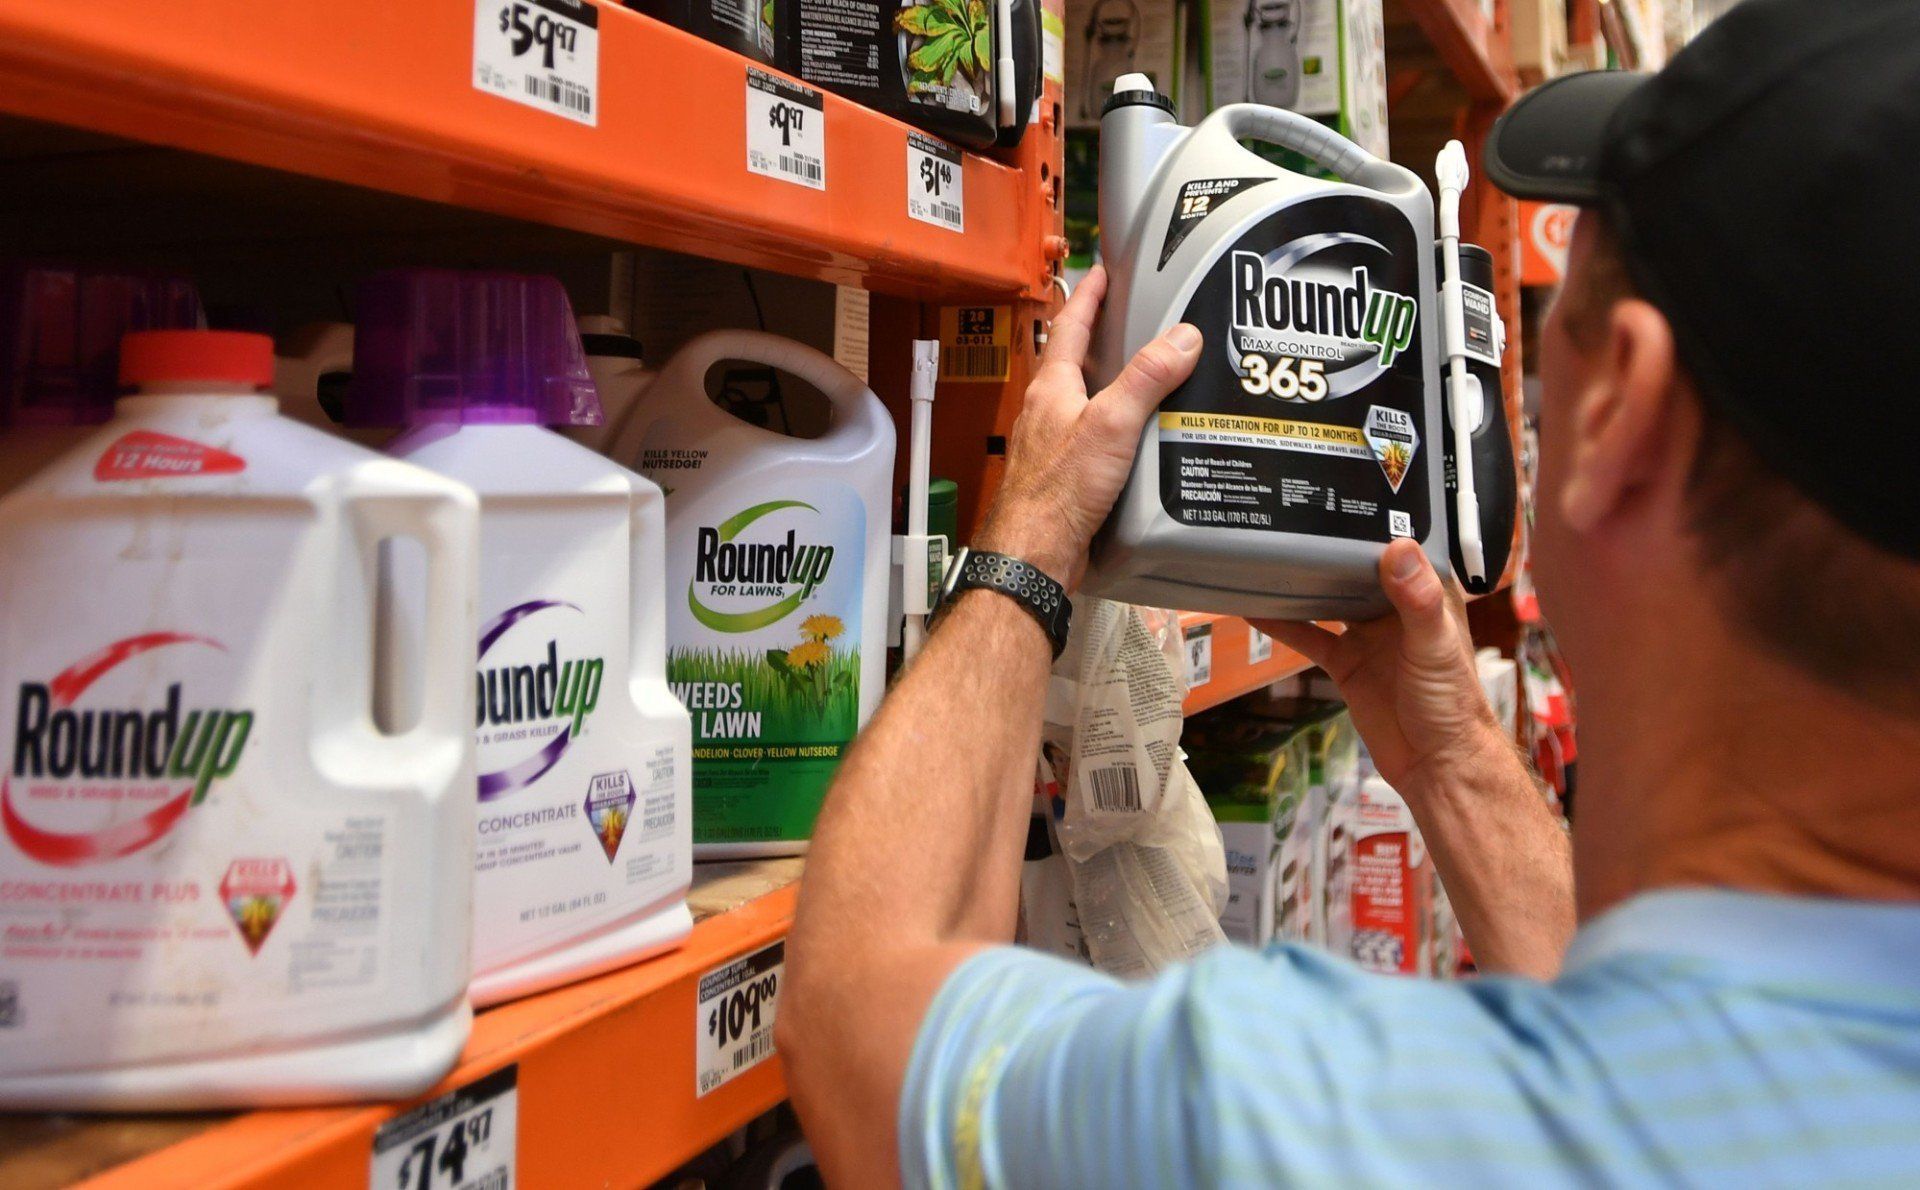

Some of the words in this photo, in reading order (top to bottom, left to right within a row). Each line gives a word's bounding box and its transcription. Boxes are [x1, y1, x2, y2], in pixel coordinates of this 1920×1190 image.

[1187, 181, 1214, 191] KILLS
[1215, 180, 1239, 188] AND
[1182, 196, 1210, 214] 12
[1180, 211, 1208, 220] MONTHS
[1232, 250, 1417, 368] Roundup
[1464, 297, 1490, 315] WAND
[1241, 336, 1275, 351] MAX
[1278, 342, 1345, 361] CONTROL
[1241, 353, 1328, 402] 365
[1375, 409, 1407, 426] KILLS
[1181, 417, 1205, 427] KILLS
[1208, 418, 1260, 431] VEGETATION
[1263, 423, 1279, 433] FOR
[1283, 425, 1294, 434] UP
[1298, 426, 1308, 436] TO
[1310, 428, 1319, 437] 12
[1323, 429, 1358, 442] MONTHS
[1376, 422, 1387, 430] THE
[1388, 423, 1407, 433] ROOTS
[643, 450, 669, 459] KILLS
[671, 450, 709, 459] YELLOW
[1219, 435, 1254, 443] DRIVEWAYS,
[1257, 437, 1277, 446] PATIOS,
[1280, 440, 1312, 449] SIDEWALKS
[1327, 445, 1348, 454] GRAVEL
[1350, 447, 1367, 456] AREAS
[142, 454, 203, 472] Hours
[642, 459, 702, 470] NUTSEDGE!
[1181, 457, 1194, 466] Keep
[1195, 457, 1204, 465] Out
[1205, 457, 1209, 465] of
[1210, 458, 1225, 466] Reach
[1226, 459, 1231, 467] of
[1232, 459, 1252, 468] Children
[1181, 466, 1209, 477] CAUTION
[1181, 488, 1221, 502] PRECAUCIÓN
[1183, 509, 1197, 520] NET
[1199, 510, 1211, 521] 1.33
[1212, 511, 1226, 522] GAL
[1227, 511, 1240, 523] (170
[1241, 513, 1249, 523] FL
[1250, 513, 1272, 526] OZ/5L)
[696, 526, 834, 601] Roundup
[711, 585, 736, 596] FOR
[476, 639, 604, 738] undup
[670, 682, 742, 709] WEEDS
[494, 730, 527, 743] GRASS
[530, 725, 558, 737] KILLER
[701, 712, 762, 739] LAWN
[13, 682, 254, 807] Roundup
[692, 749, 730, 758] ANDELION
[733, 748, 763, 758] CLOVER
[767, 747, 797, 757] YELLOW
[799, 746, 838, 757] NUTSEDGE
[596, 776, 624, 791] KILLS
[478, 804, 577, 834] CONCENTRATE
[0, 882, 144, 901] CONCENTRATE
[152, 882, 201, 901] PLUS
